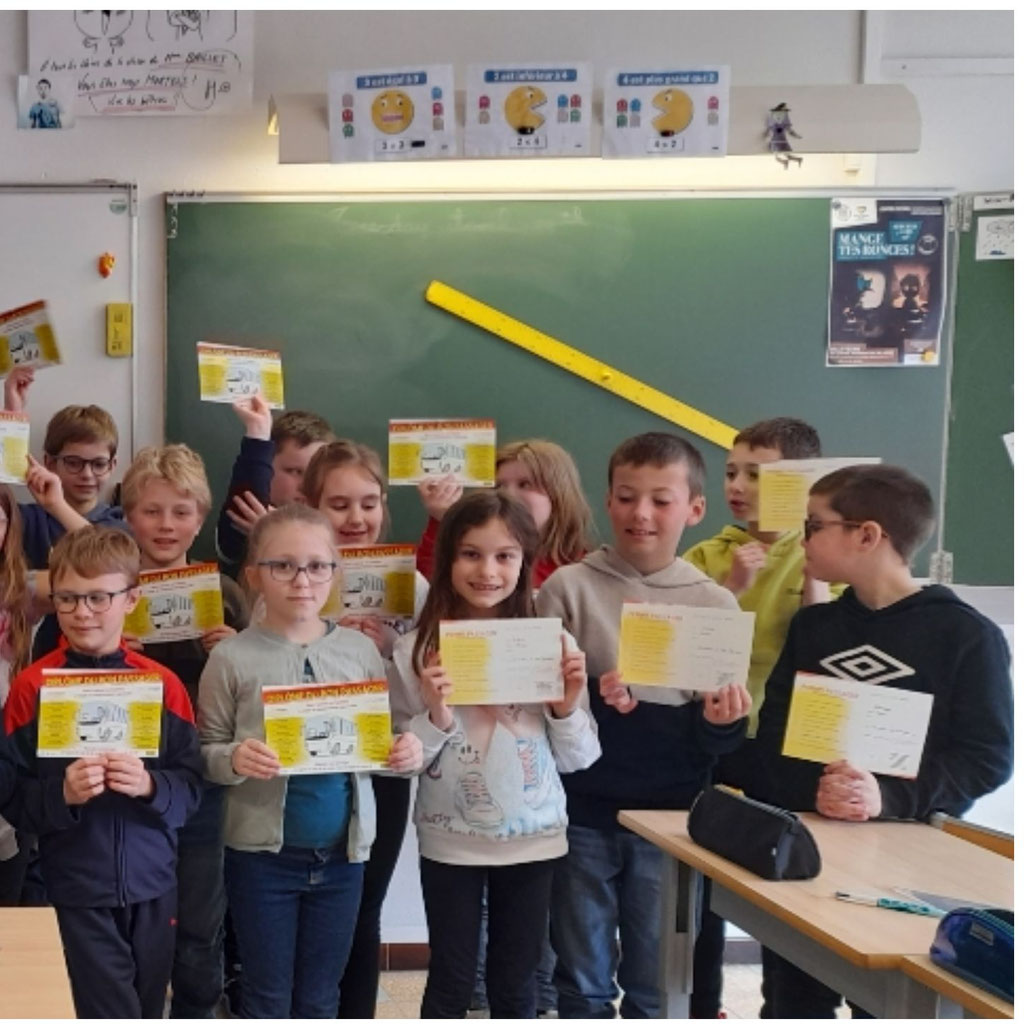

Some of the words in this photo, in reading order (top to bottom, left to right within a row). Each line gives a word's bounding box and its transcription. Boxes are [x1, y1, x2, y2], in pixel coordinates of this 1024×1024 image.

[517, 137, 523, 146] 2
[840, 232, 884, 244] MANGE
[840, 245, 861, 256] TES
[320, 688, 338, 698] BON
